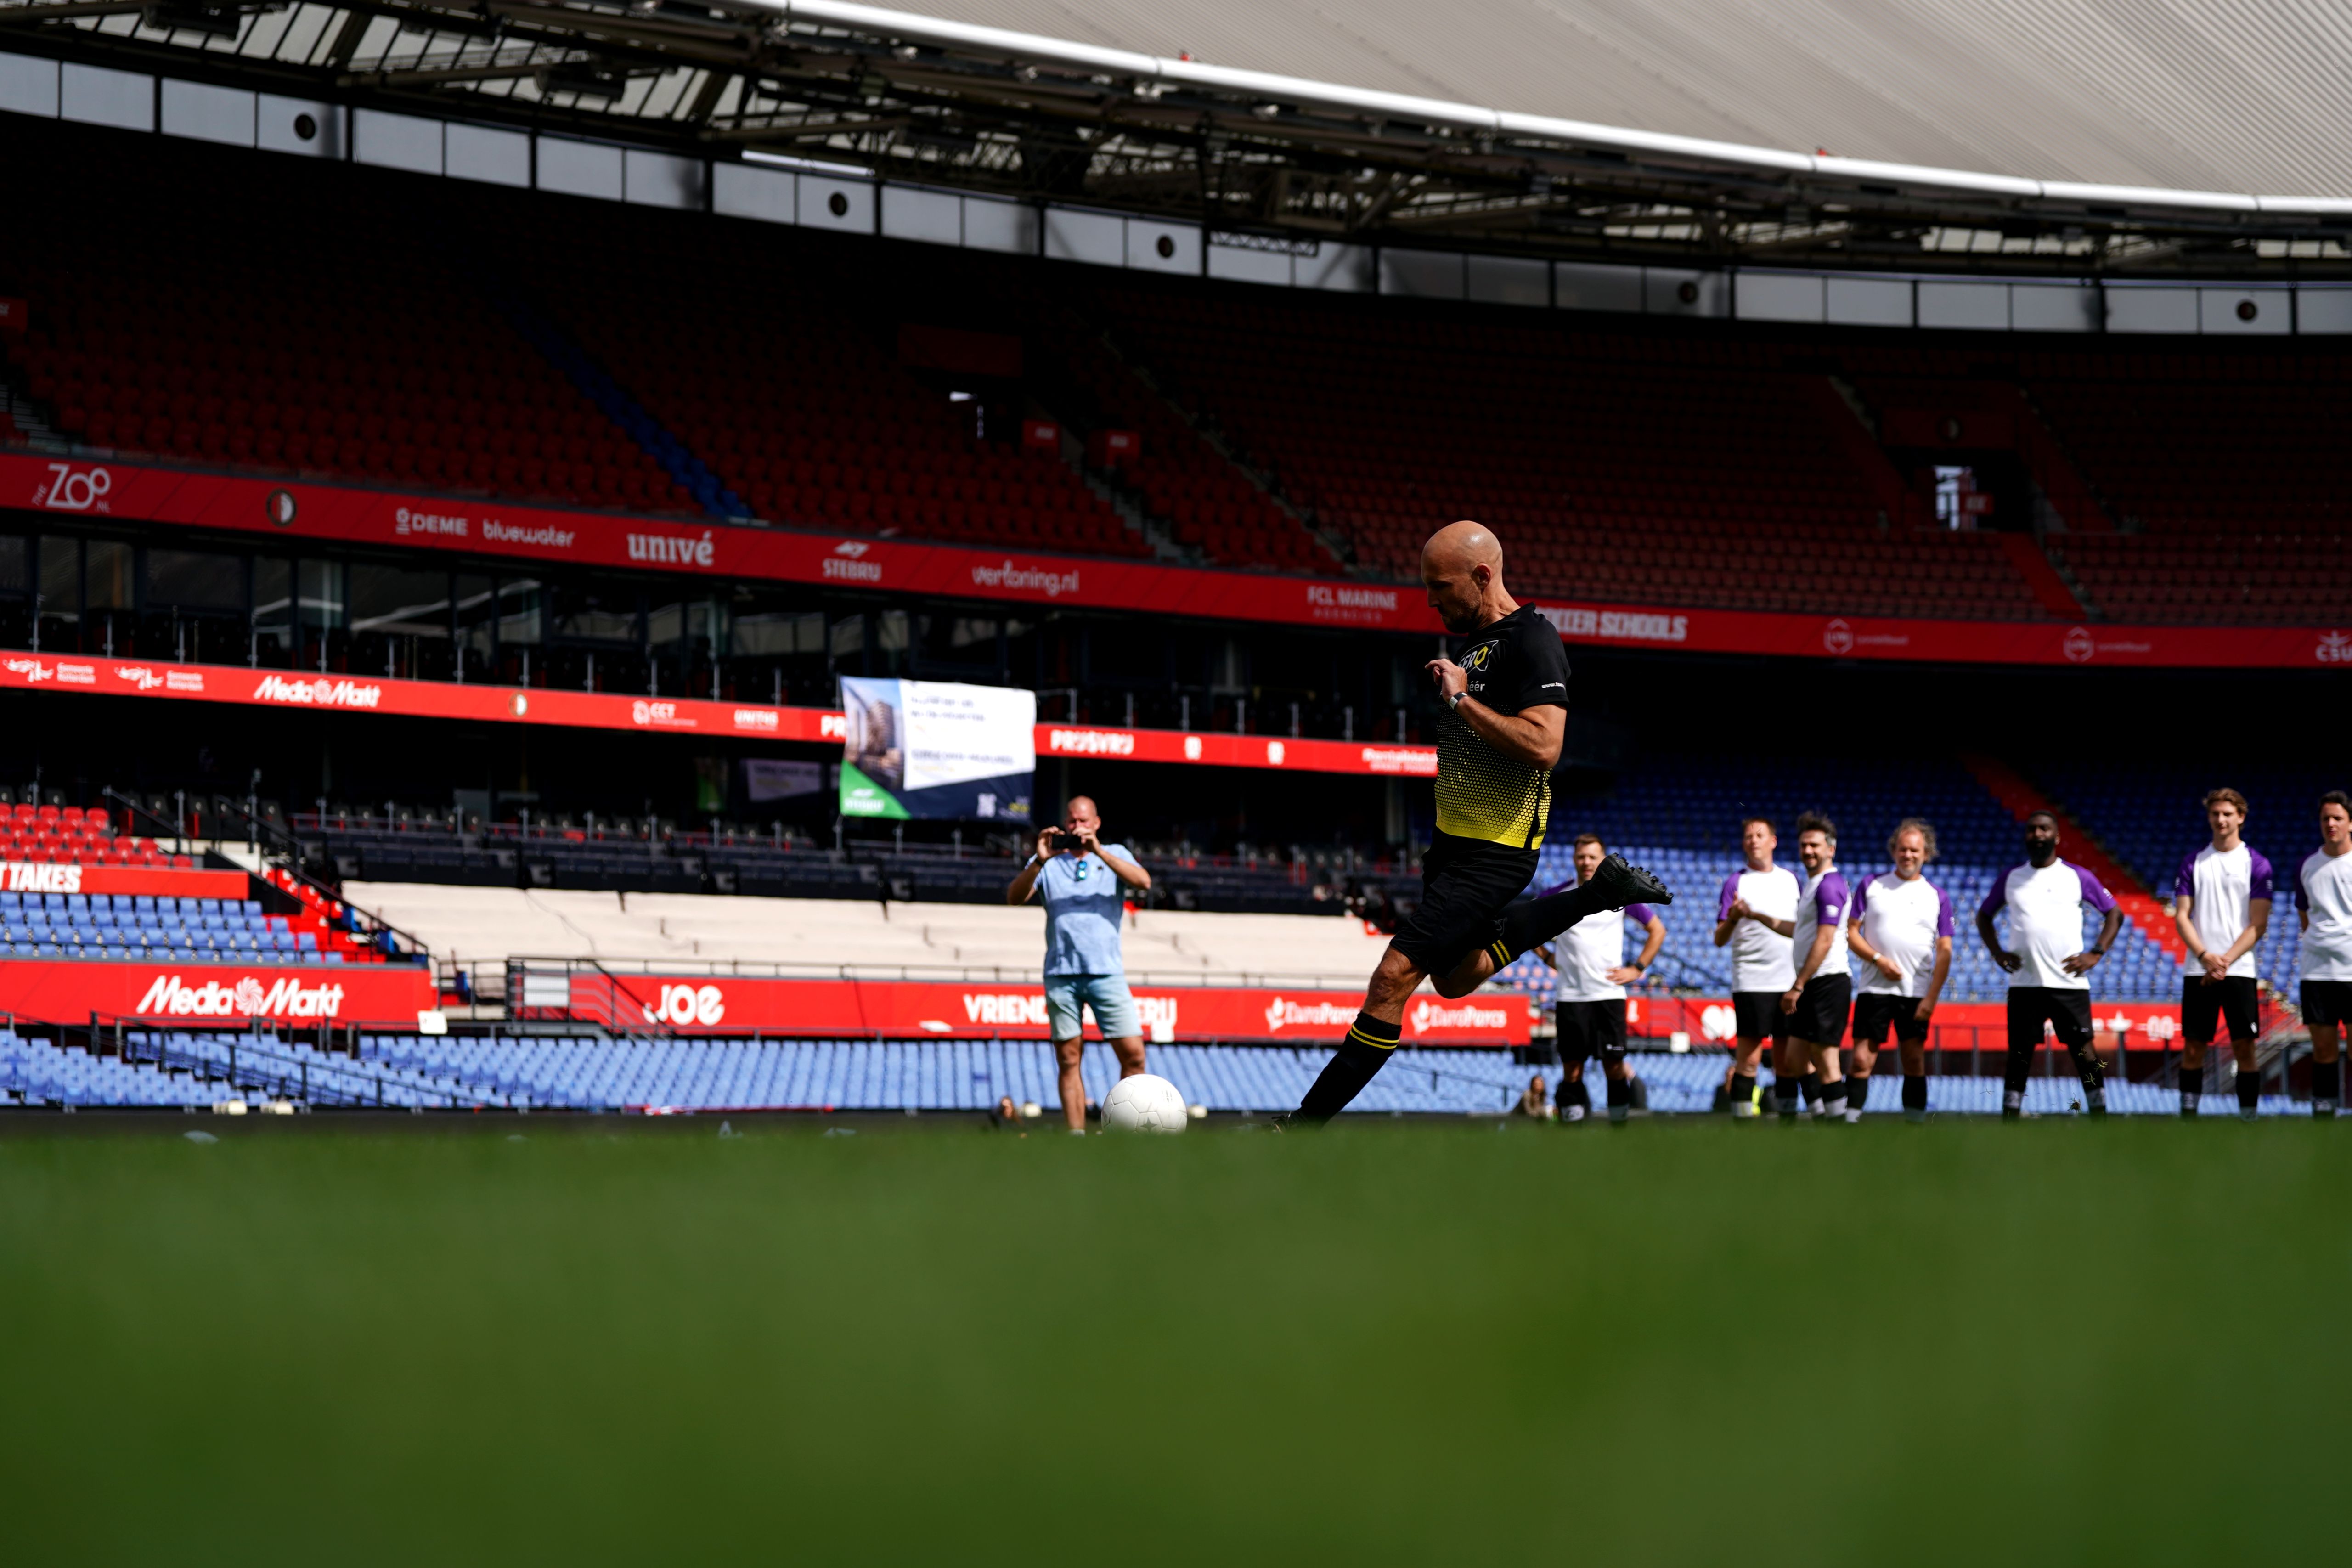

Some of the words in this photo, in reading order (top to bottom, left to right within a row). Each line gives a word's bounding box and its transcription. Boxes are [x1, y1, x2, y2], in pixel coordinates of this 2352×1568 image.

[412, 513, 468, 537] DEME
[483, 513, 575, 547] bluewater
[626, 530, 715, 567] univé
[822, 558, 882, 582] STEBRU
[1307, 585, 1335, 606] FCL
[1337, 587, 1398, 612] MARINE
[1599, 610, 1688, 643] SCHOOLS
[8, 862, 83, 894] TAKES
